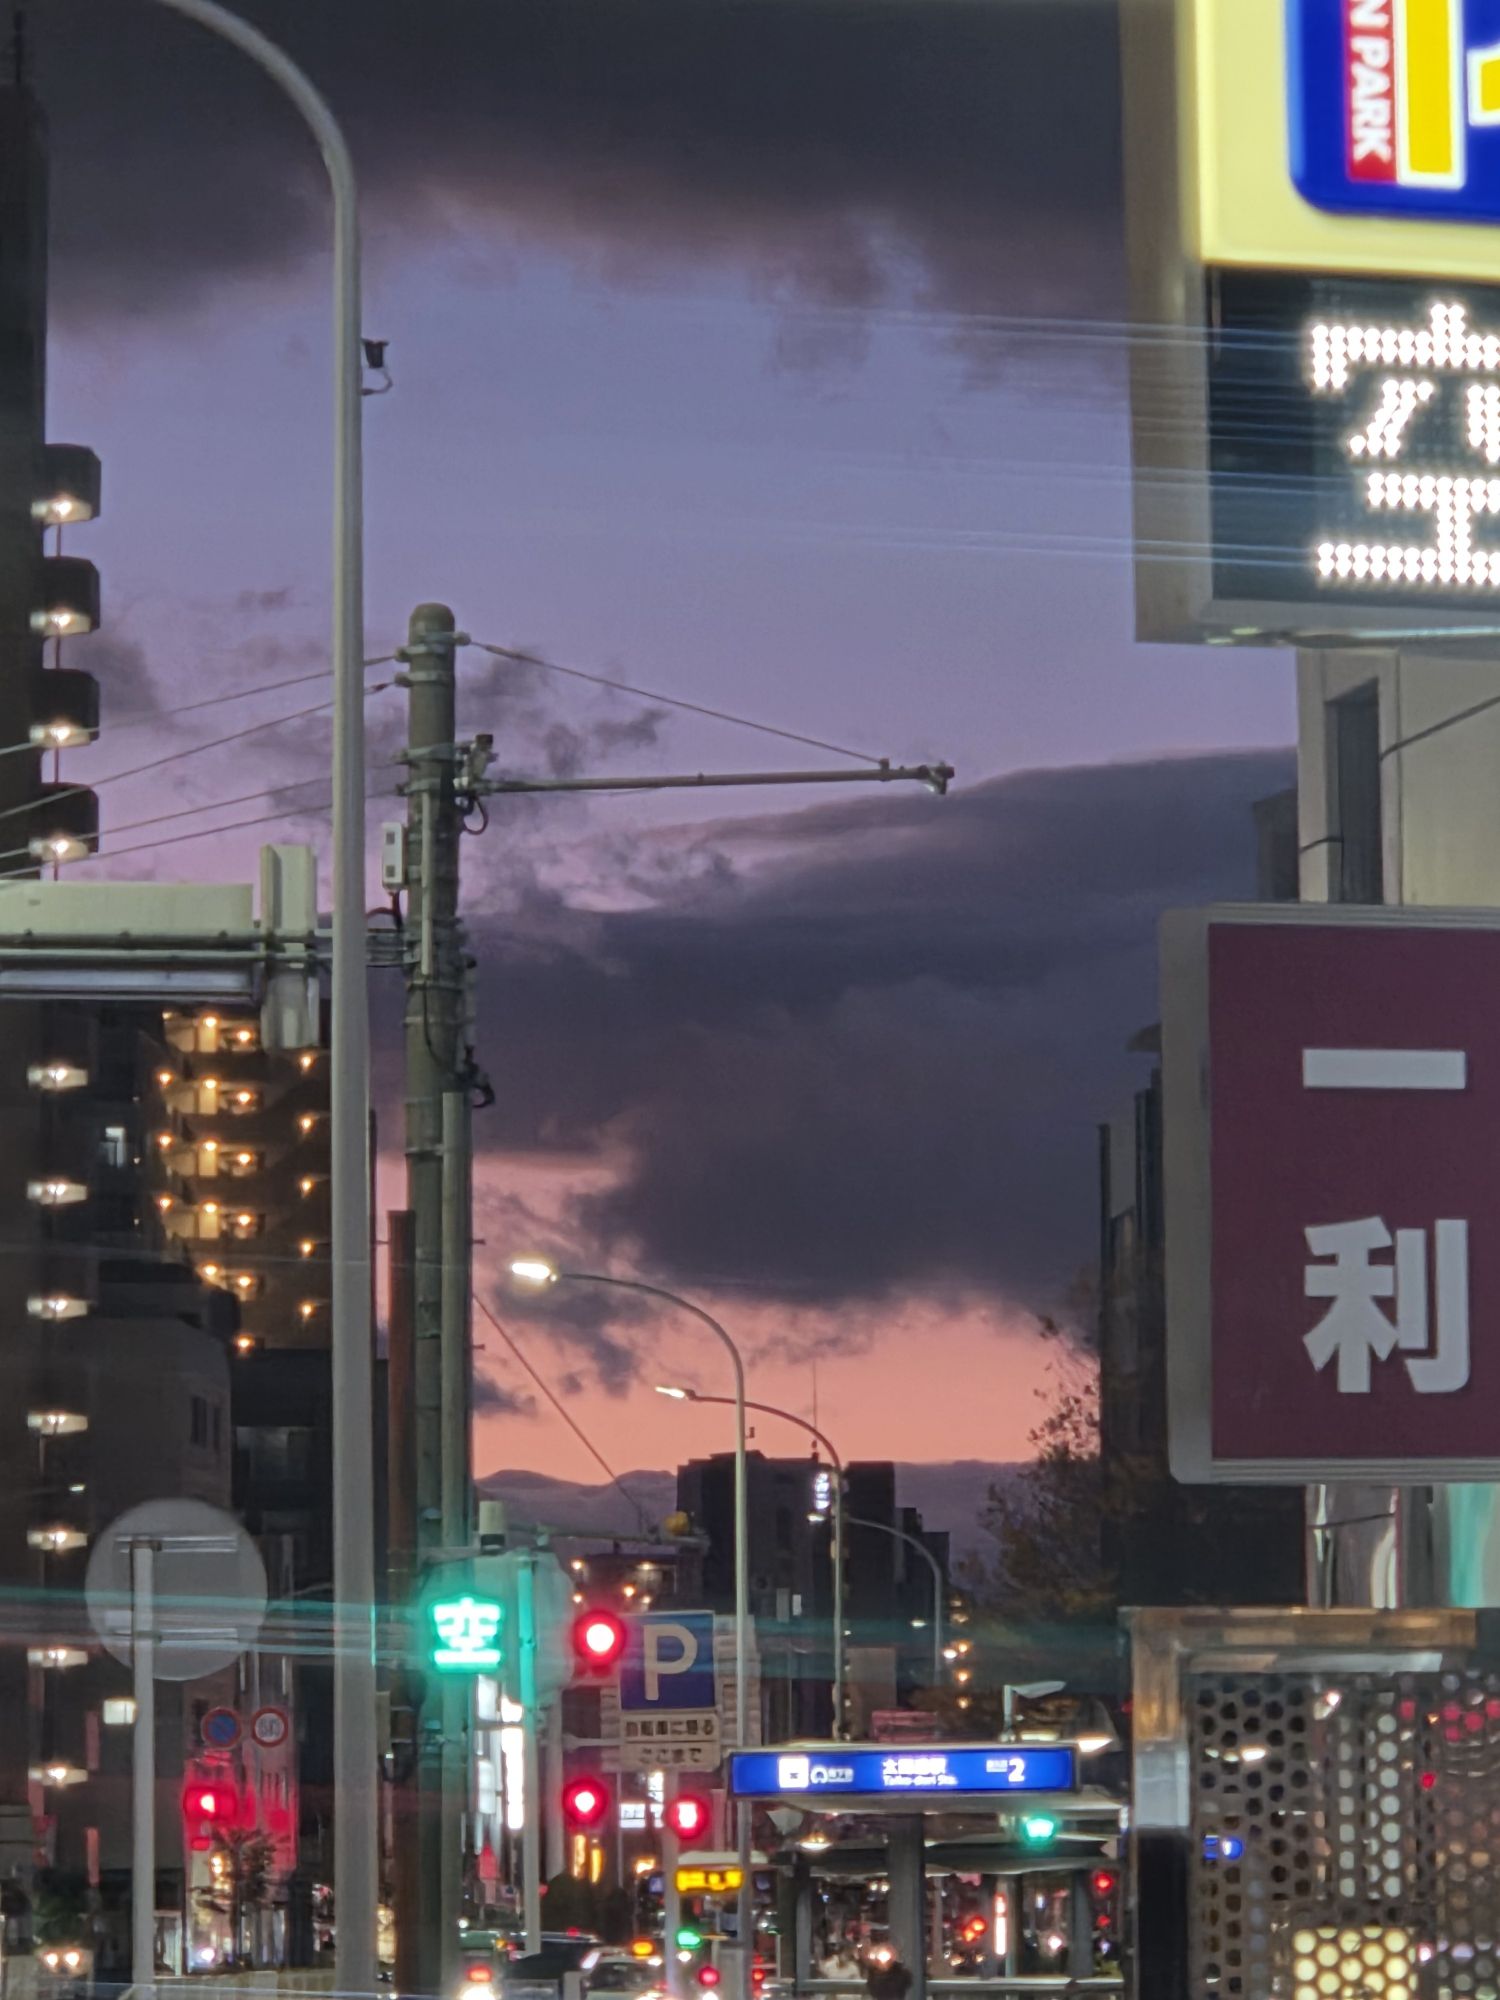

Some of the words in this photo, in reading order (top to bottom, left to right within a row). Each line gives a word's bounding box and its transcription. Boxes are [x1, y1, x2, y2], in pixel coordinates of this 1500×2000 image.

[1351, 36, 1392, 164] PARK
[643, 1623, 698, 1701] P
[1008, 1757, 1025, 1782] 2
